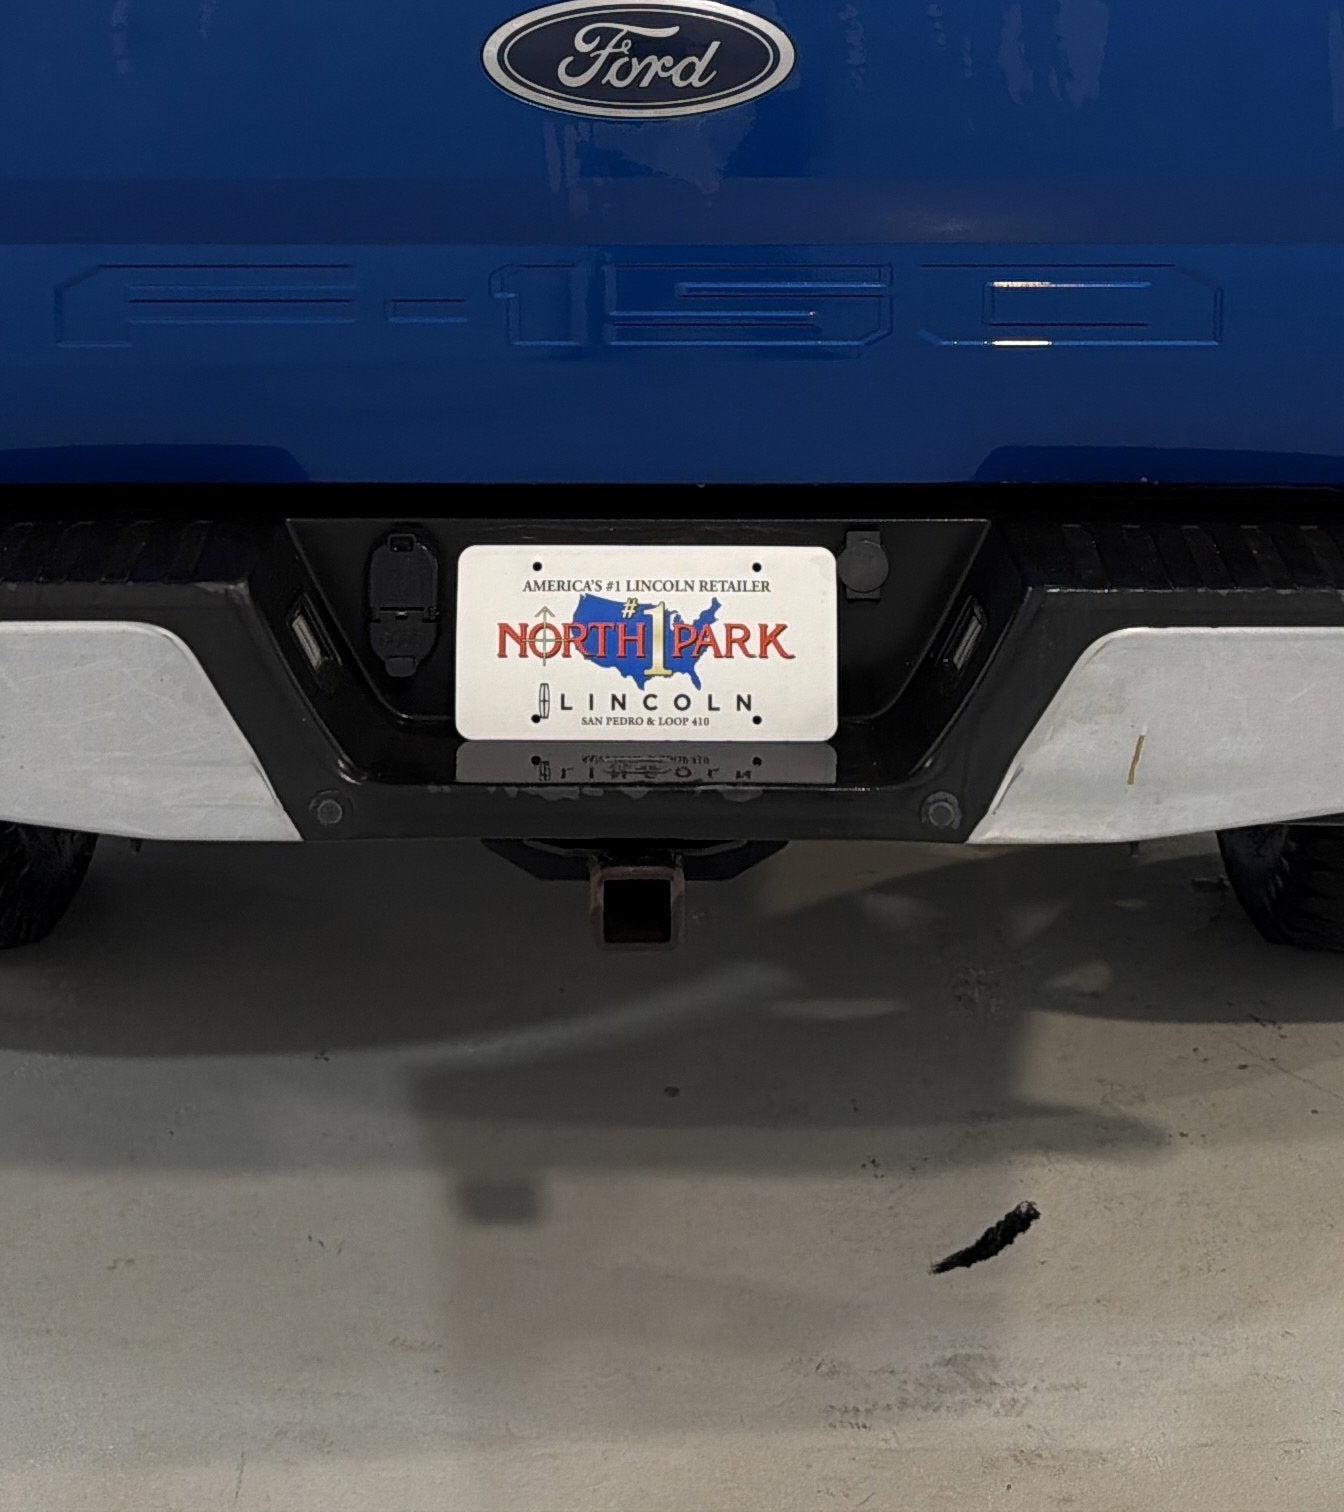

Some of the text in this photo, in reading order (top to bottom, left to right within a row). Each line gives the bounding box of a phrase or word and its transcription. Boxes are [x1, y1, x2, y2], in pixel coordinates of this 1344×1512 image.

[557, 22, 721, 88] Ford
[523, 579, 771, 593] AMERICA'S #1 LINCOLN RETAILER
[497, 622, 796, 659] NORTH PARK
[560, 692, 753, 711] LINCOLN
[581, 716, 710, 726] SAN PEDRO & LOOP 410
